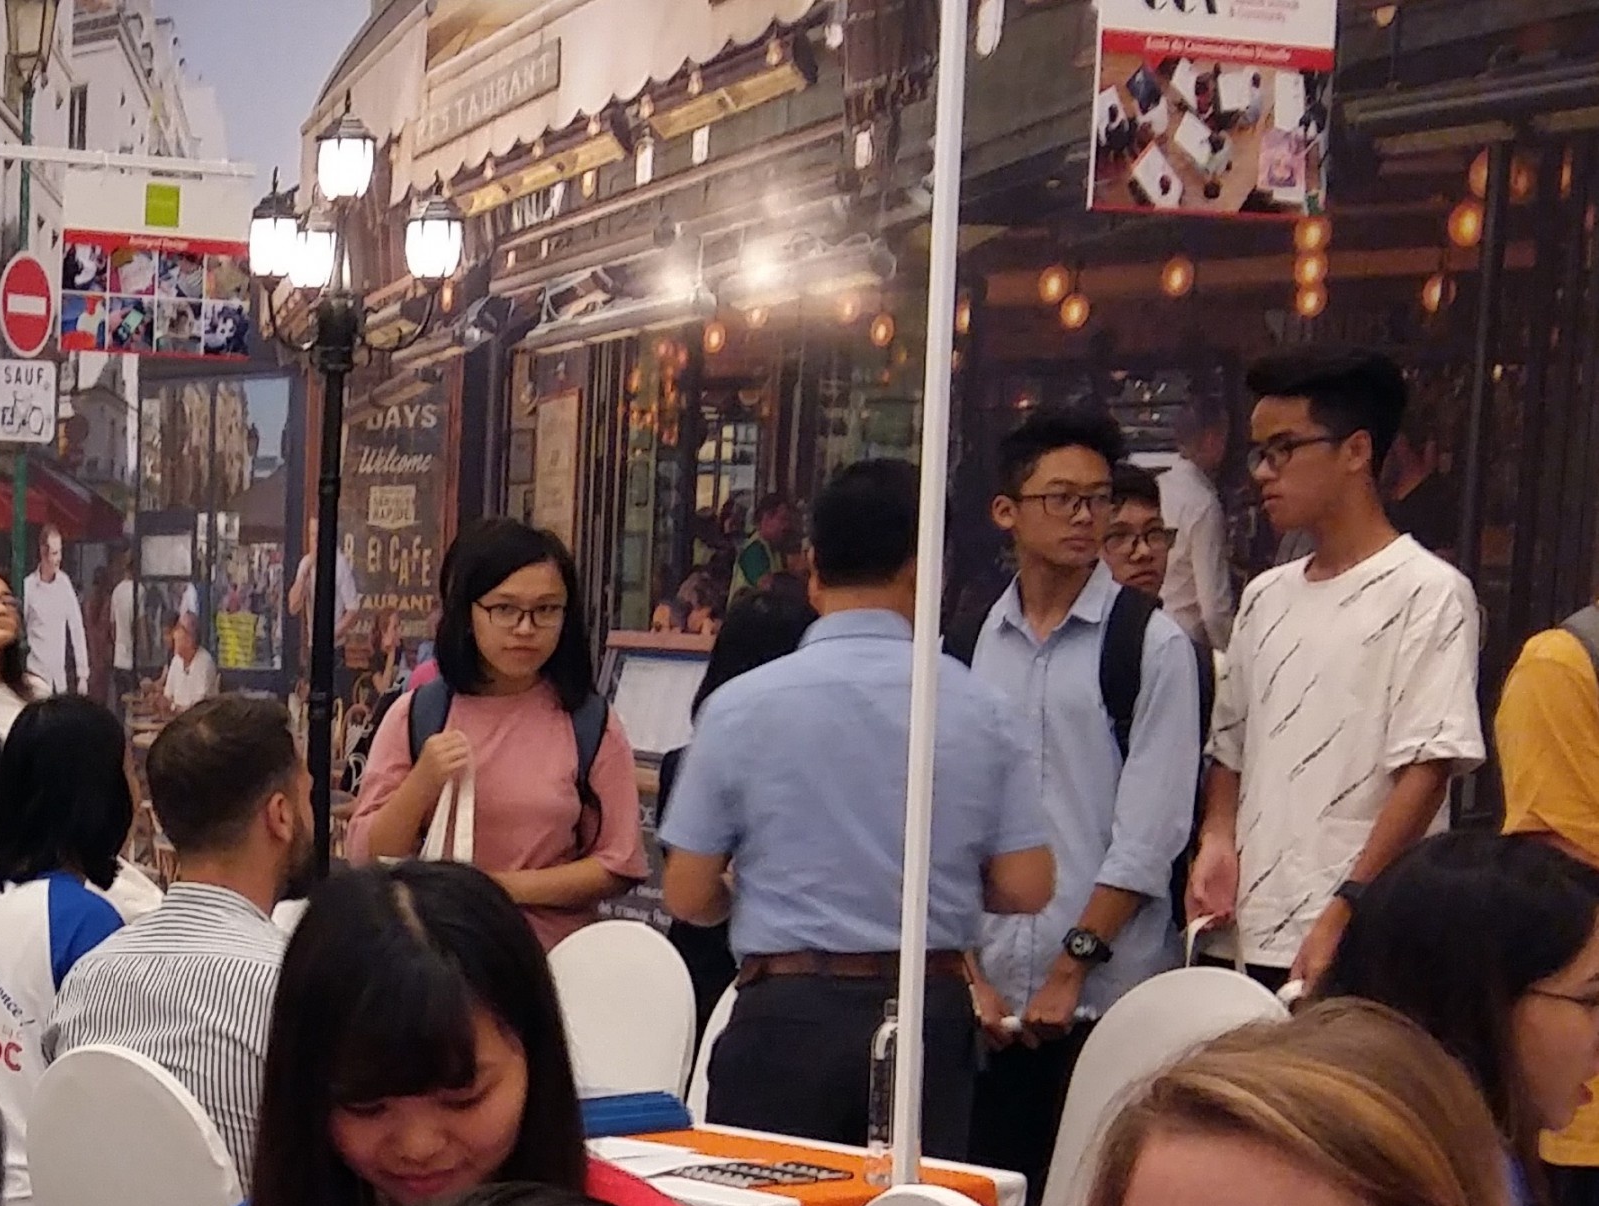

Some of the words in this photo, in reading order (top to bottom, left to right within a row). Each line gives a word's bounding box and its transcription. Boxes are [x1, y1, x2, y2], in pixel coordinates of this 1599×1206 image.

[416, 52, 551, 146] RESTAURANT
[4, 365, 44, 386] SAUF
[366, 404, 438, 431] DAYS
[358, 443, 433, 475] Welcome
[357, 593, 435, 611] TAURANT
